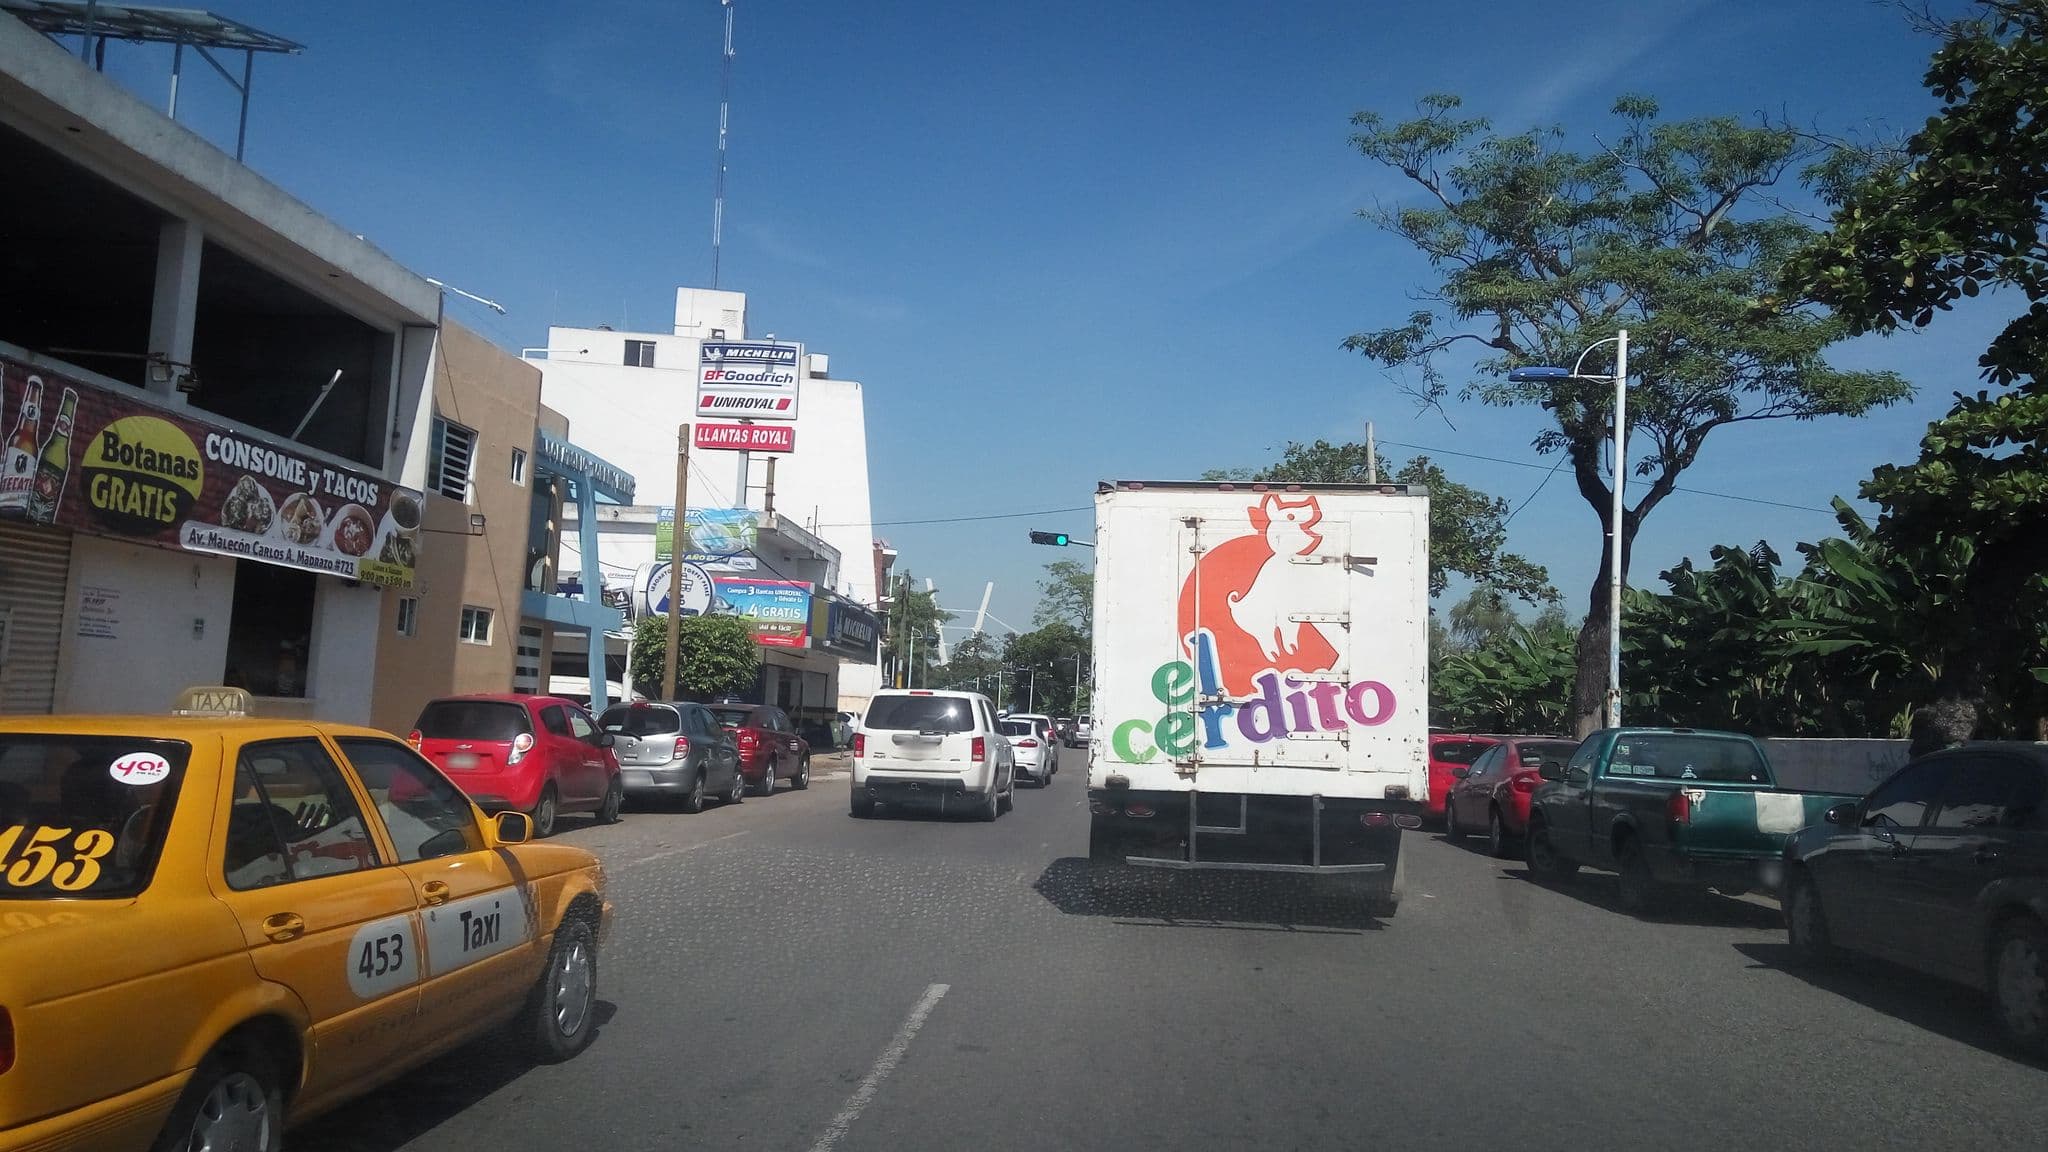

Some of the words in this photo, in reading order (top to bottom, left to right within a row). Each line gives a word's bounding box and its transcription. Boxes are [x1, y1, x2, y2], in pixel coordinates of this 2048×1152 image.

[726, 348, 794, 359] MICHELIN
[704, 370, 794, 383] BFGoodrich
[713, 396, 774, 409] UNIROYAL
[697, 427, 748, 442] LLANTAS
[751, 430, 788, 444] ROYAL
[101, 430, 199, 480] Botanas
[206, 433, 306, 486] CONSOME
[323, 469, 379, 506] TACOS
[90, 473, 177, 523] GRATIS
[188, 528, 205, 545] Av.
[334, 558, 354, 574] #723
[747, 586, 754, 595] 3
[762, 607, 801, 619] GRATIS
[1151, 631, 1219, 705] el
[193, 692, 237, 710] TAXI
[1112, 673, 1397, 765] cerdito
[358, 933, 403, 979] 453
[460, 901, 500, 952] Taxi
